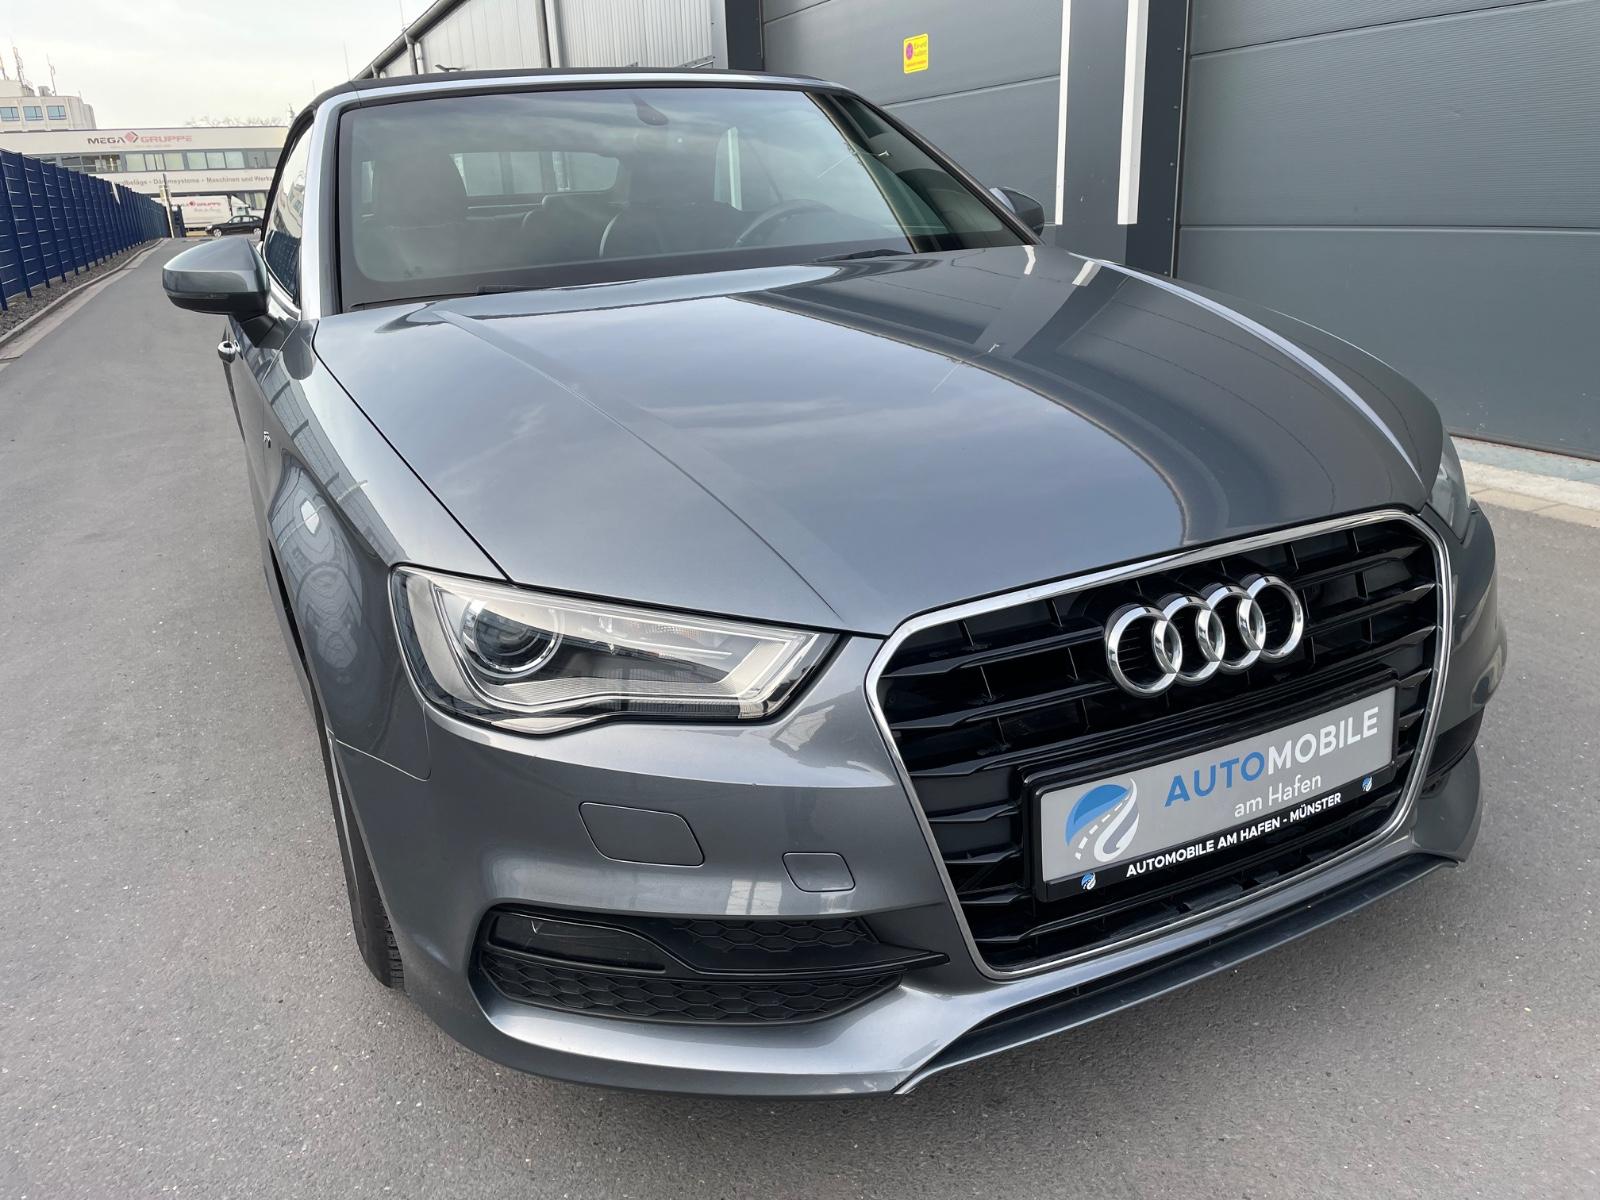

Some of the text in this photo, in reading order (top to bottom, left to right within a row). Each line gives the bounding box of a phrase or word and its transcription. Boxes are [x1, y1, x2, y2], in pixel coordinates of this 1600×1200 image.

[87, 135, 192, 144] MEGA GRUPPE
[1165, 706, 1379, 807] AUTOMOBILE
[1234, 774, 1321, 818] am Hafen
[1126, 840, 1214, 878] AUTOMOBILE
[1217, 832, 1237, 850] AM
[1240, 816, 1280, 841] HAFEN
[1289, 793, 1341, 823] MÜNSTER
